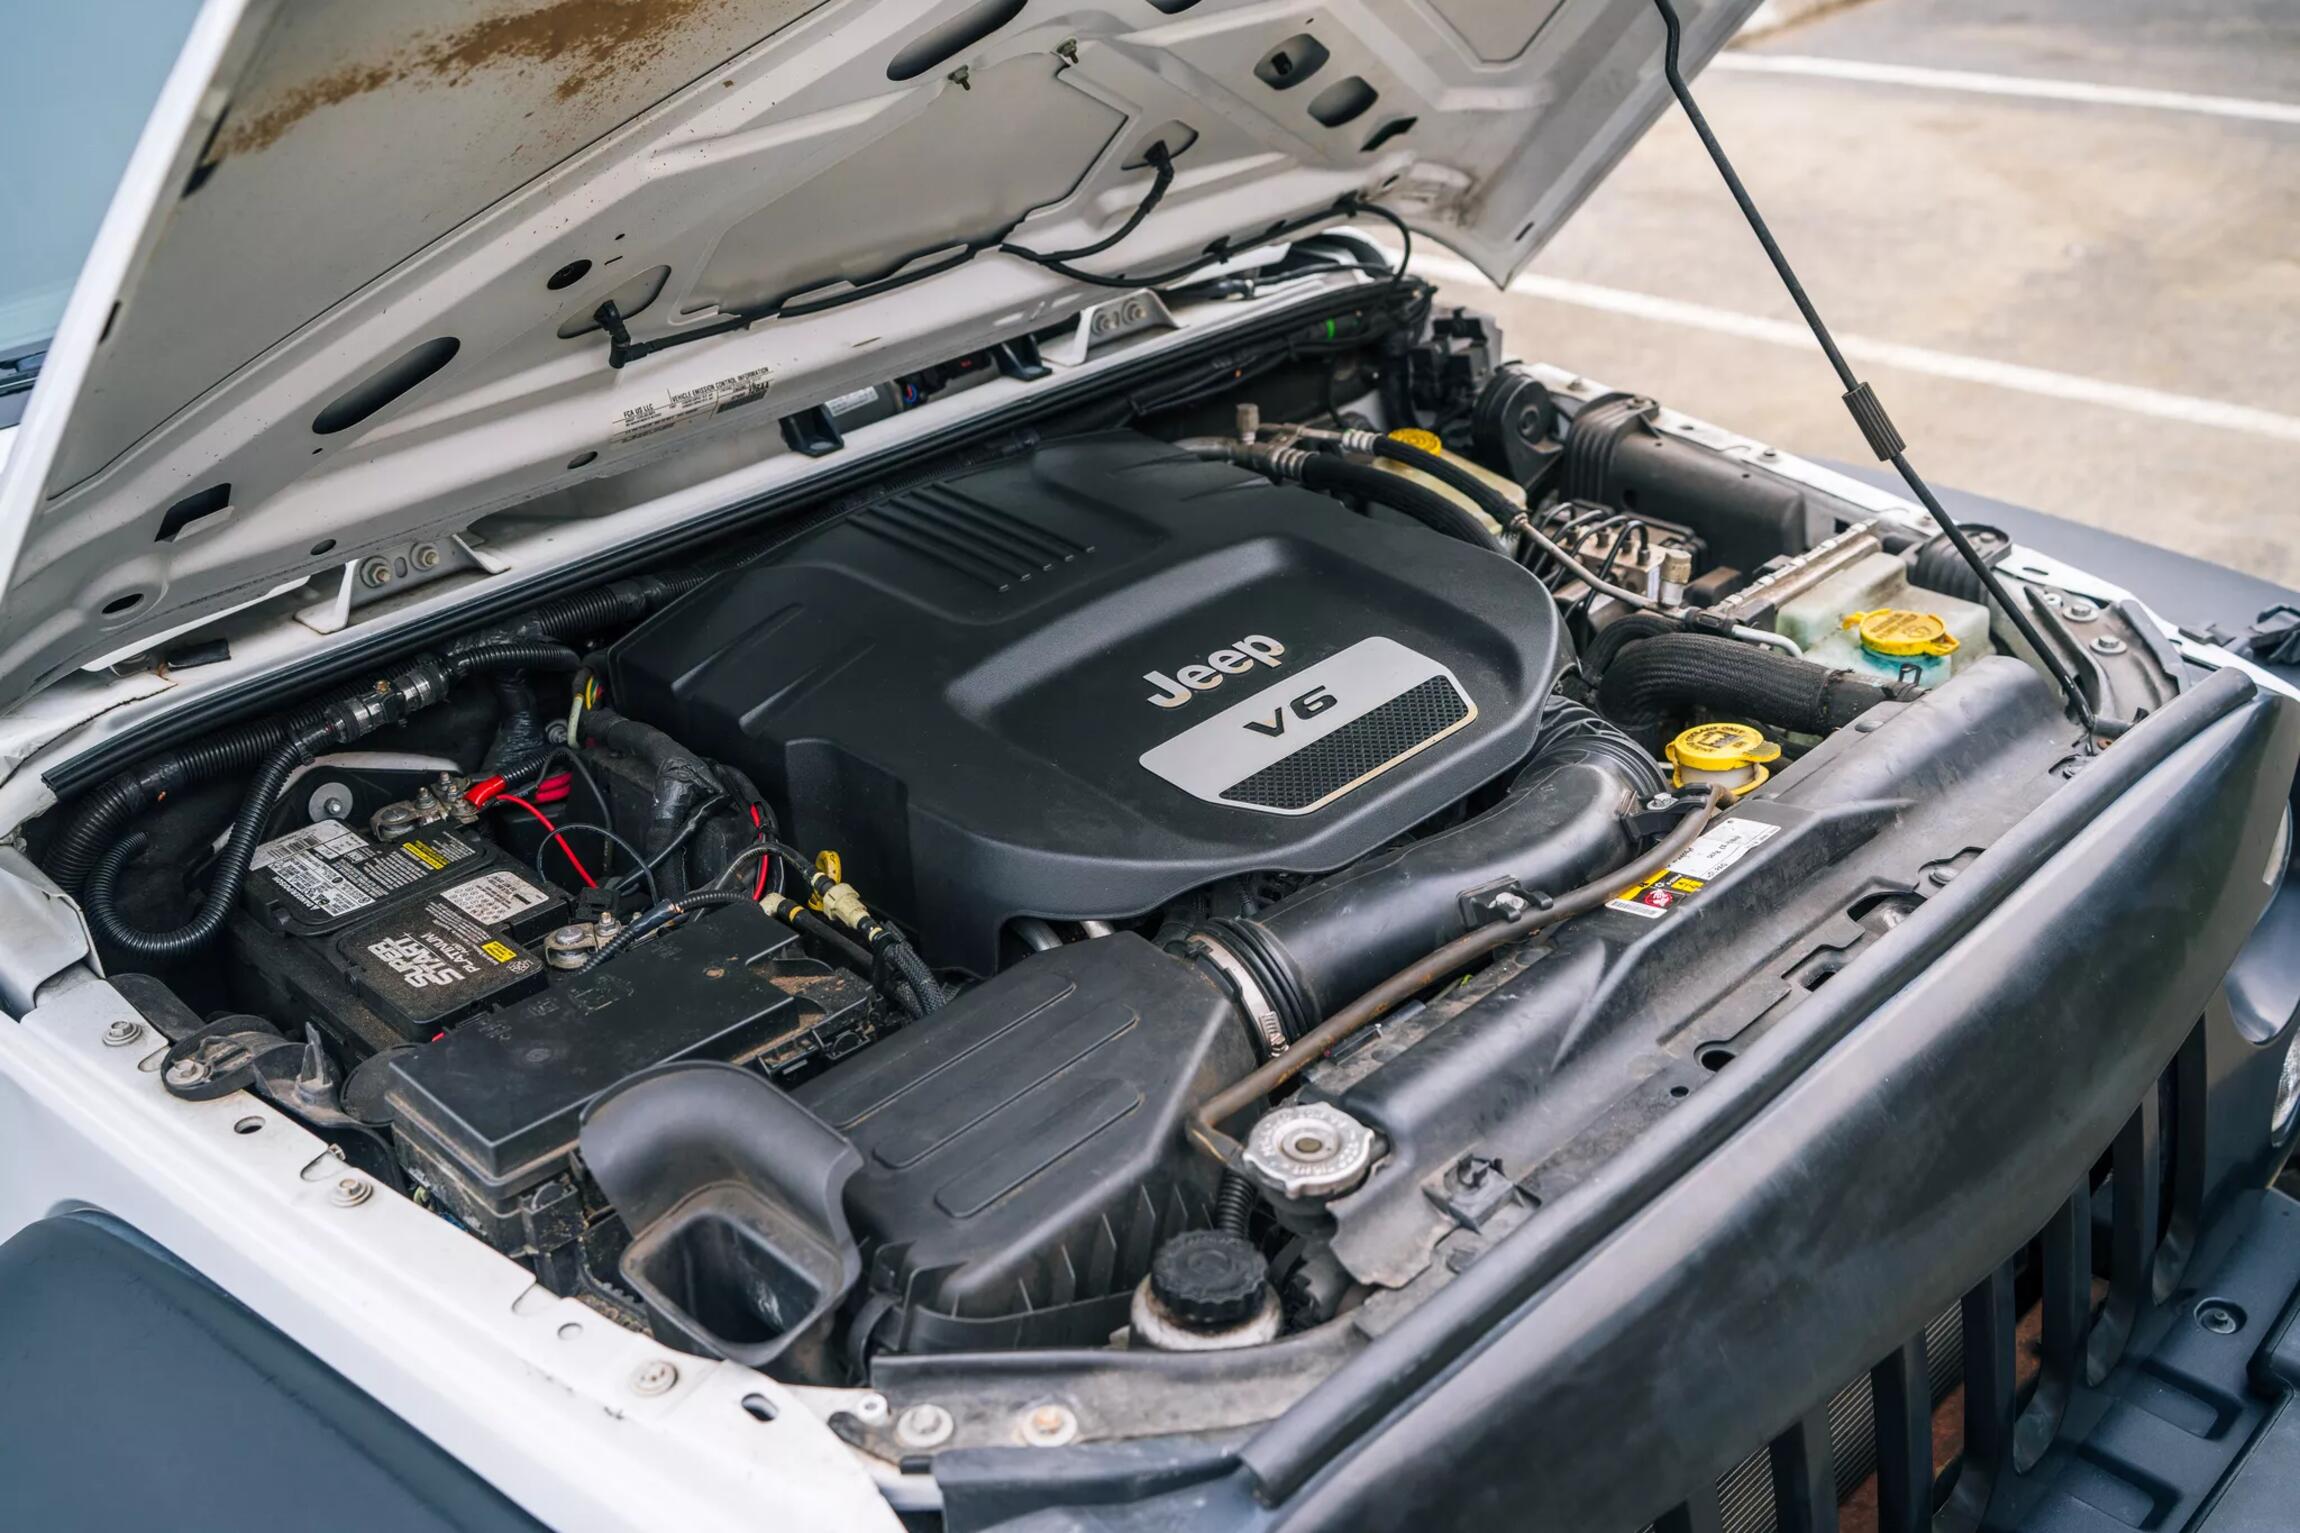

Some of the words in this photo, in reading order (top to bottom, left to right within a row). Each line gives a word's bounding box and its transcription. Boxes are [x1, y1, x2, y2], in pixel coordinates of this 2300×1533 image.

[672, 391, 692, 402] VEHICLE
[692, 384, 716, 397] EMISSION
[716, 377, 737, 391] CONTROL
[737, 366, 770, 384] INFORMATION
[624, 410, 635, 419] FCA
[635, 406, 644, 415] US
[643, 403, 654, 412] LLC
[1142, 633, 1287, 710] Jeep
[1242, 685, 1339, 738] V6
[367, 940, 429, 988] SUPER
[384, 937, 467, 986] START
[420, 932, 481, 973] PLATINUM
